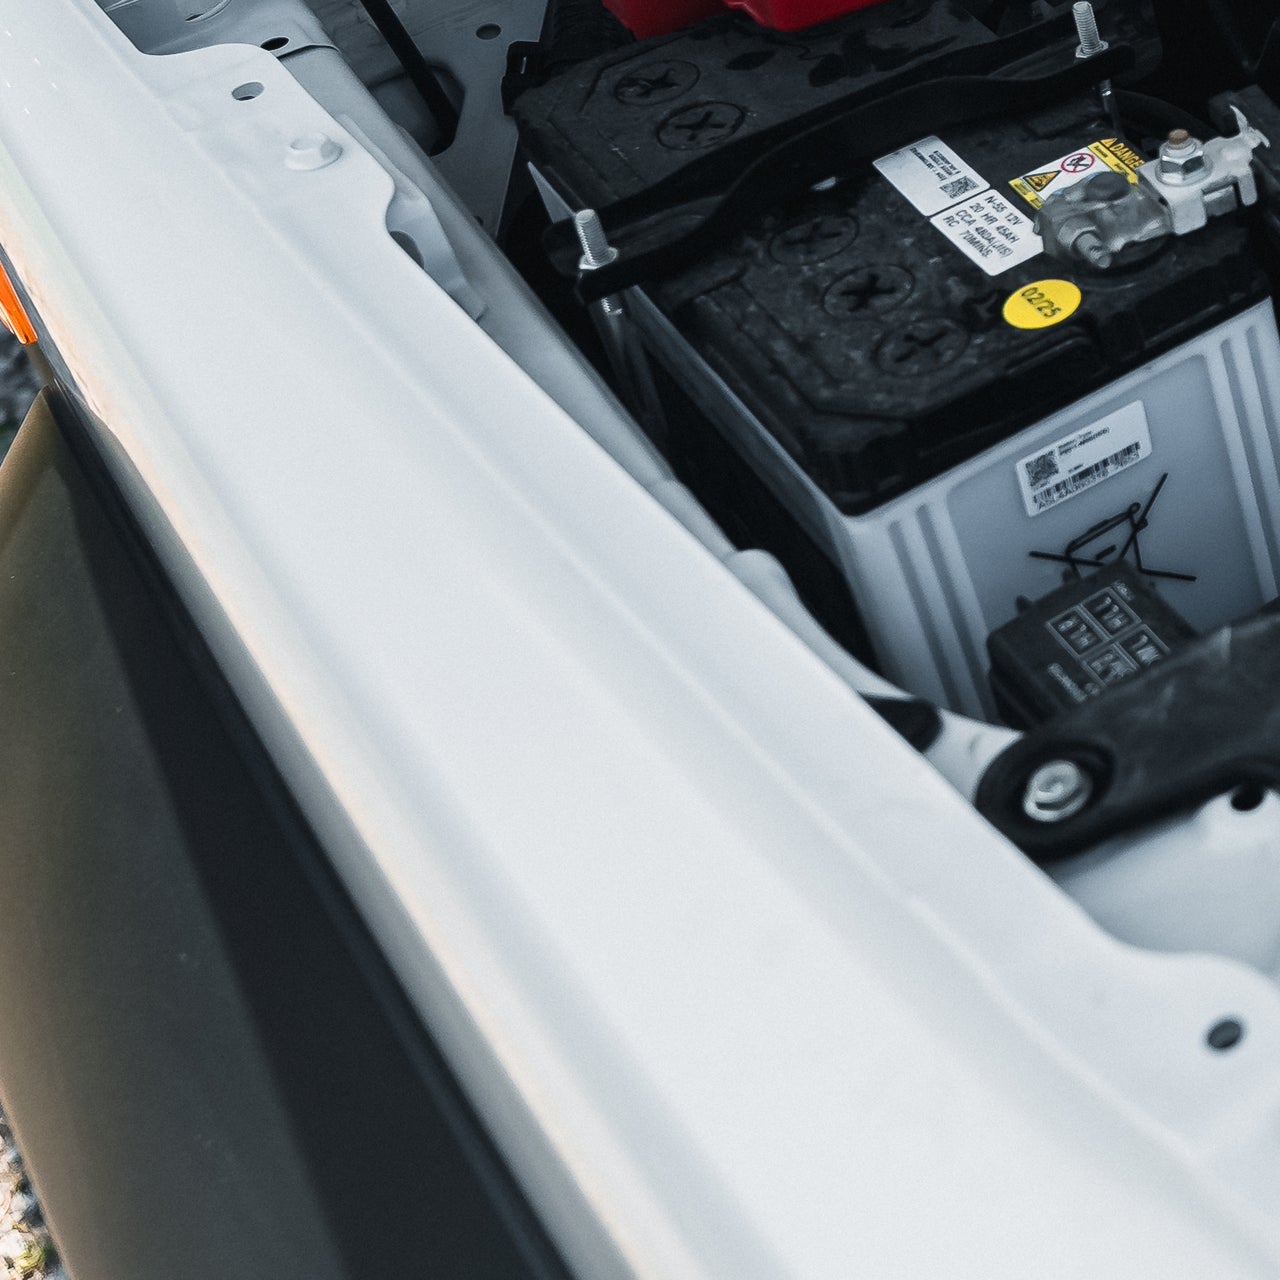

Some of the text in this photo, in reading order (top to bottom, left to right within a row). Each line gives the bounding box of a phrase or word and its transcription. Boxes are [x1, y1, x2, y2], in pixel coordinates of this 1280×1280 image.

[1109, 142, 1145, 170] DANGE
[943, 215, 960, 227] RC
[955, 209, 977, 227] CCA
[1021, 287, 1062, 318] 02/25
